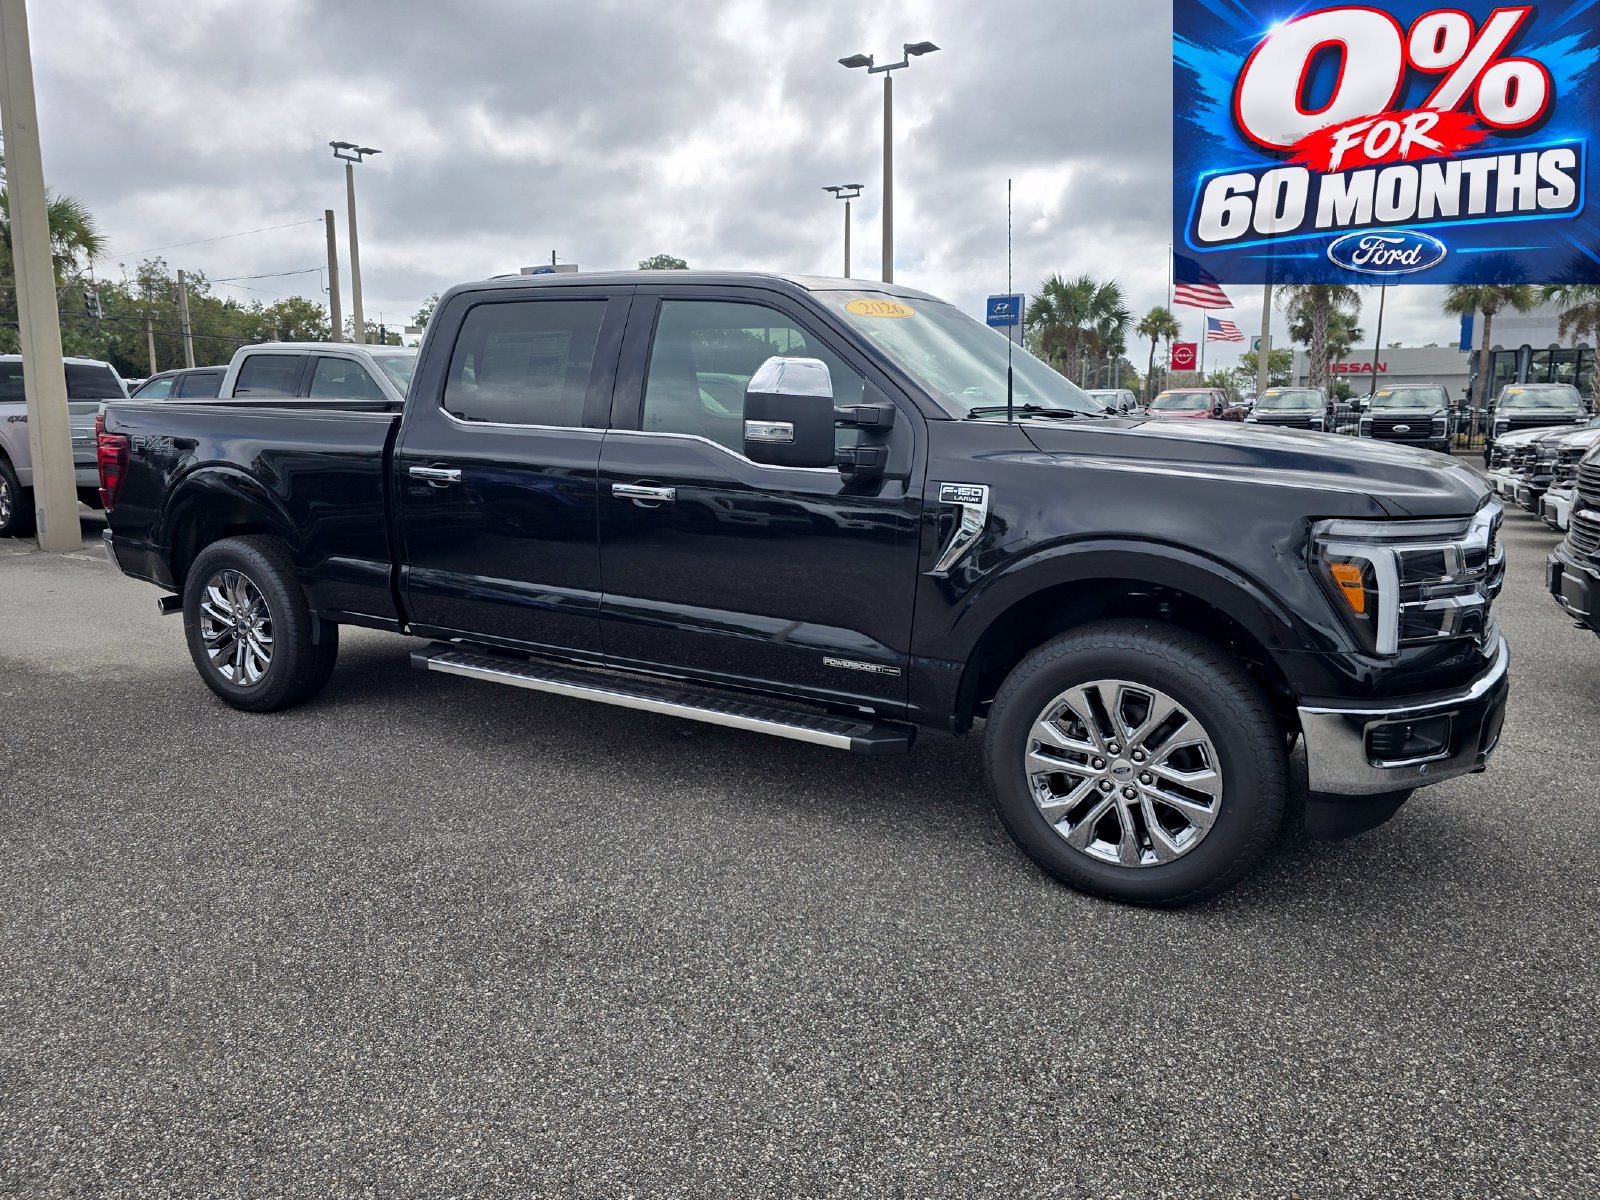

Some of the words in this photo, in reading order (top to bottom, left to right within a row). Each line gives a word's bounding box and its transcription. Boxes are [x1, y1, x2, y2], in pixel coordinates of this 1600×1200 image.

[858, 302, 905, 314] 2026
[1326, 361, 1387, 374] ISSAN
[132, 435, 175, 453] FX4
[942, 486, 982, 496] F-150
[824, 658, 882, 672] POWERBOOST
